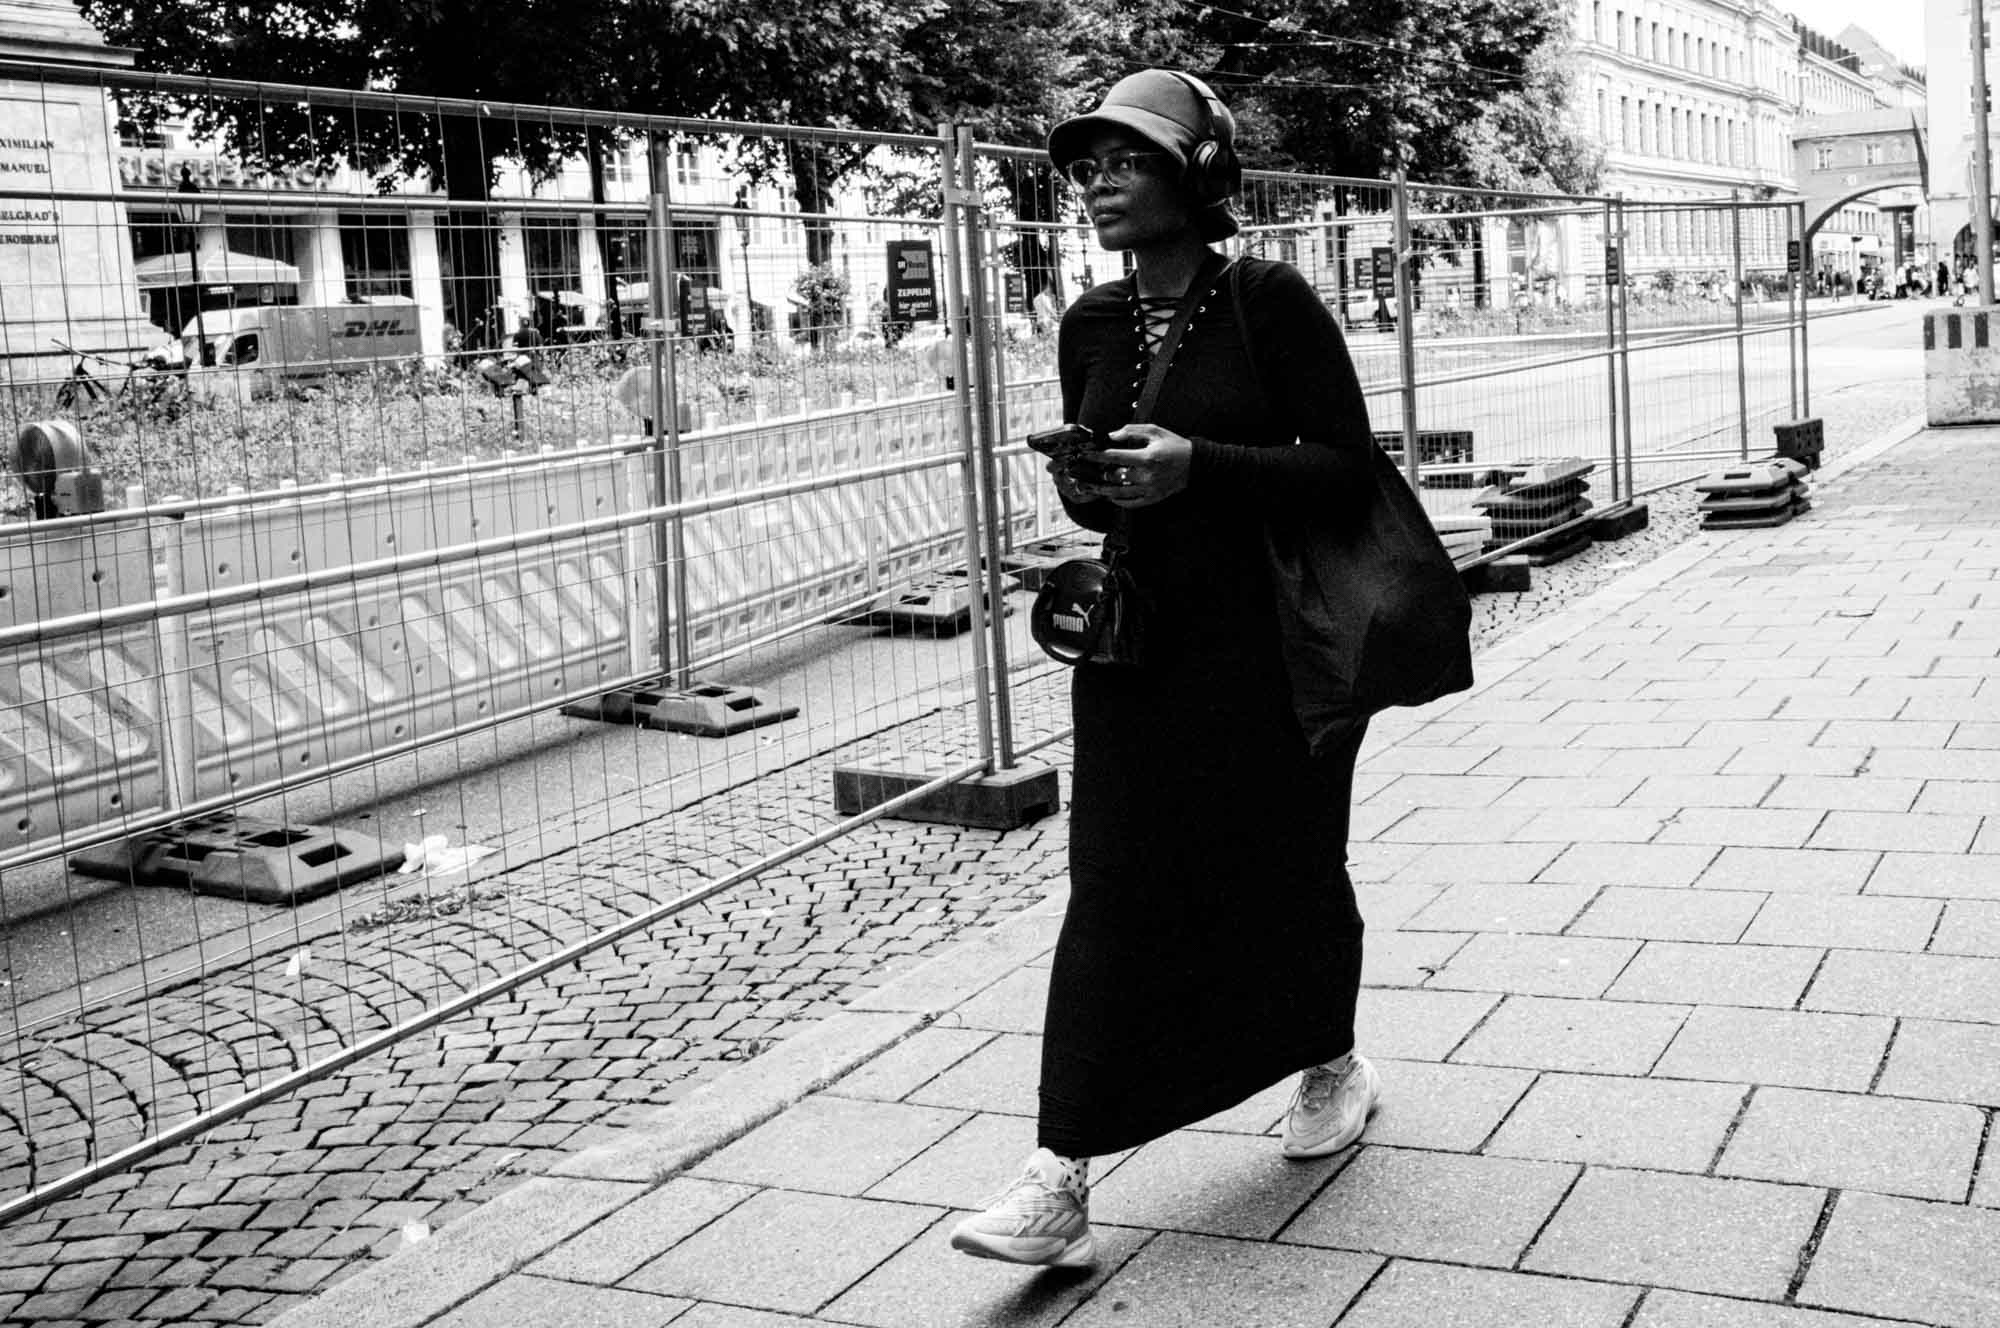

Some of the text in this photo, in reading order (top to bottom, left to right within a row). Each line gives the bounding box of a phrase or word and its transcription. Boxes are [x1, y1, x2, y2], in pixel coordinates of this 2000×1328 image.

[897, 287, 931, 297] ZEPPELIN
[344, 320, 404, 337] DHL
[1053, 614, 1084, 633] PUMA
